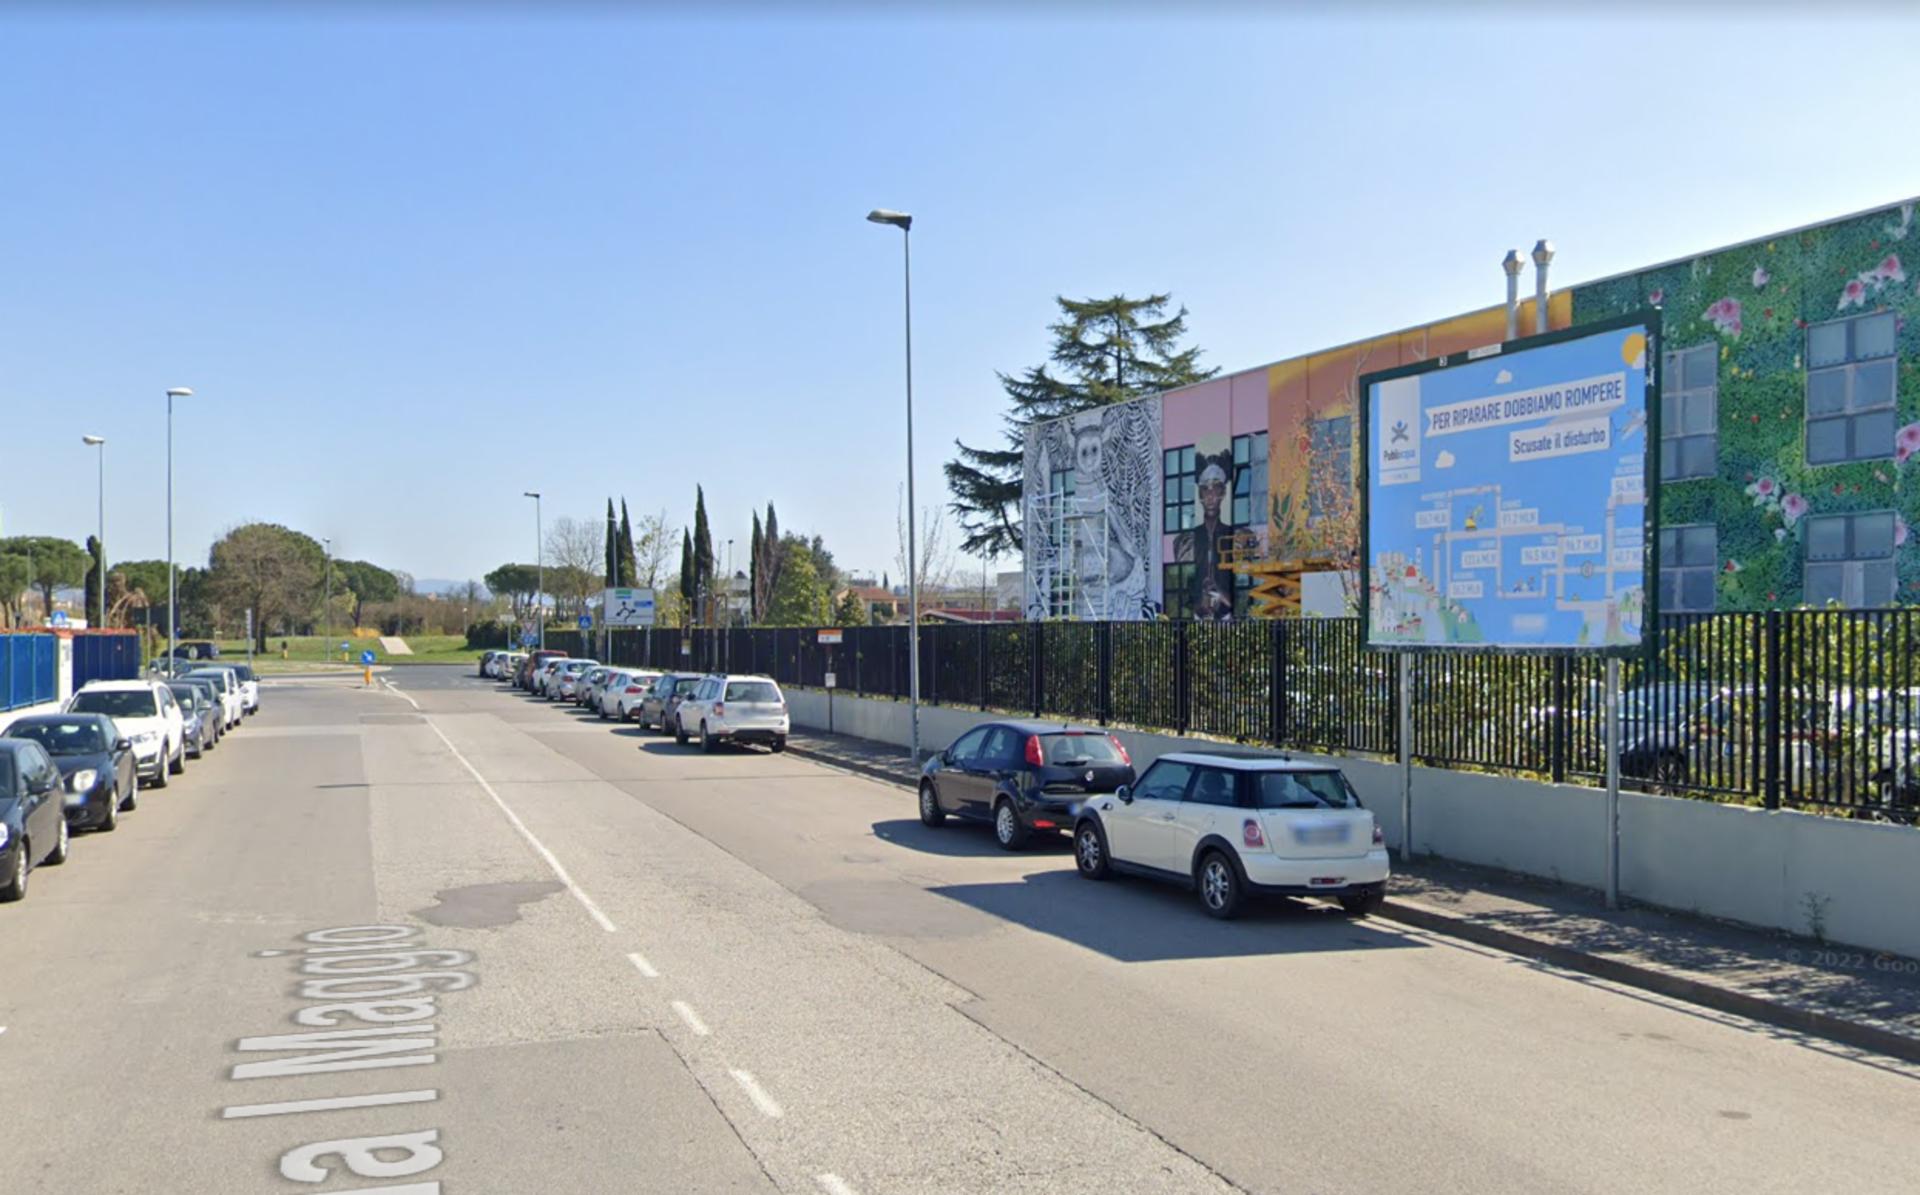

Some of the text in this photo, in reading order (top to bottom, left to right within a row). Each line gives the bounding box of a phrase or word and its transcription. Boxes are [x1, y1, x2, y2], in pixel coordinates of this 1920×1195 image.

[1432, 380, 1621, 430] PER RIPARARE DOBBIAMO ROMPERE
[1513, 429, 1606, 454] Scusate il disturbo
